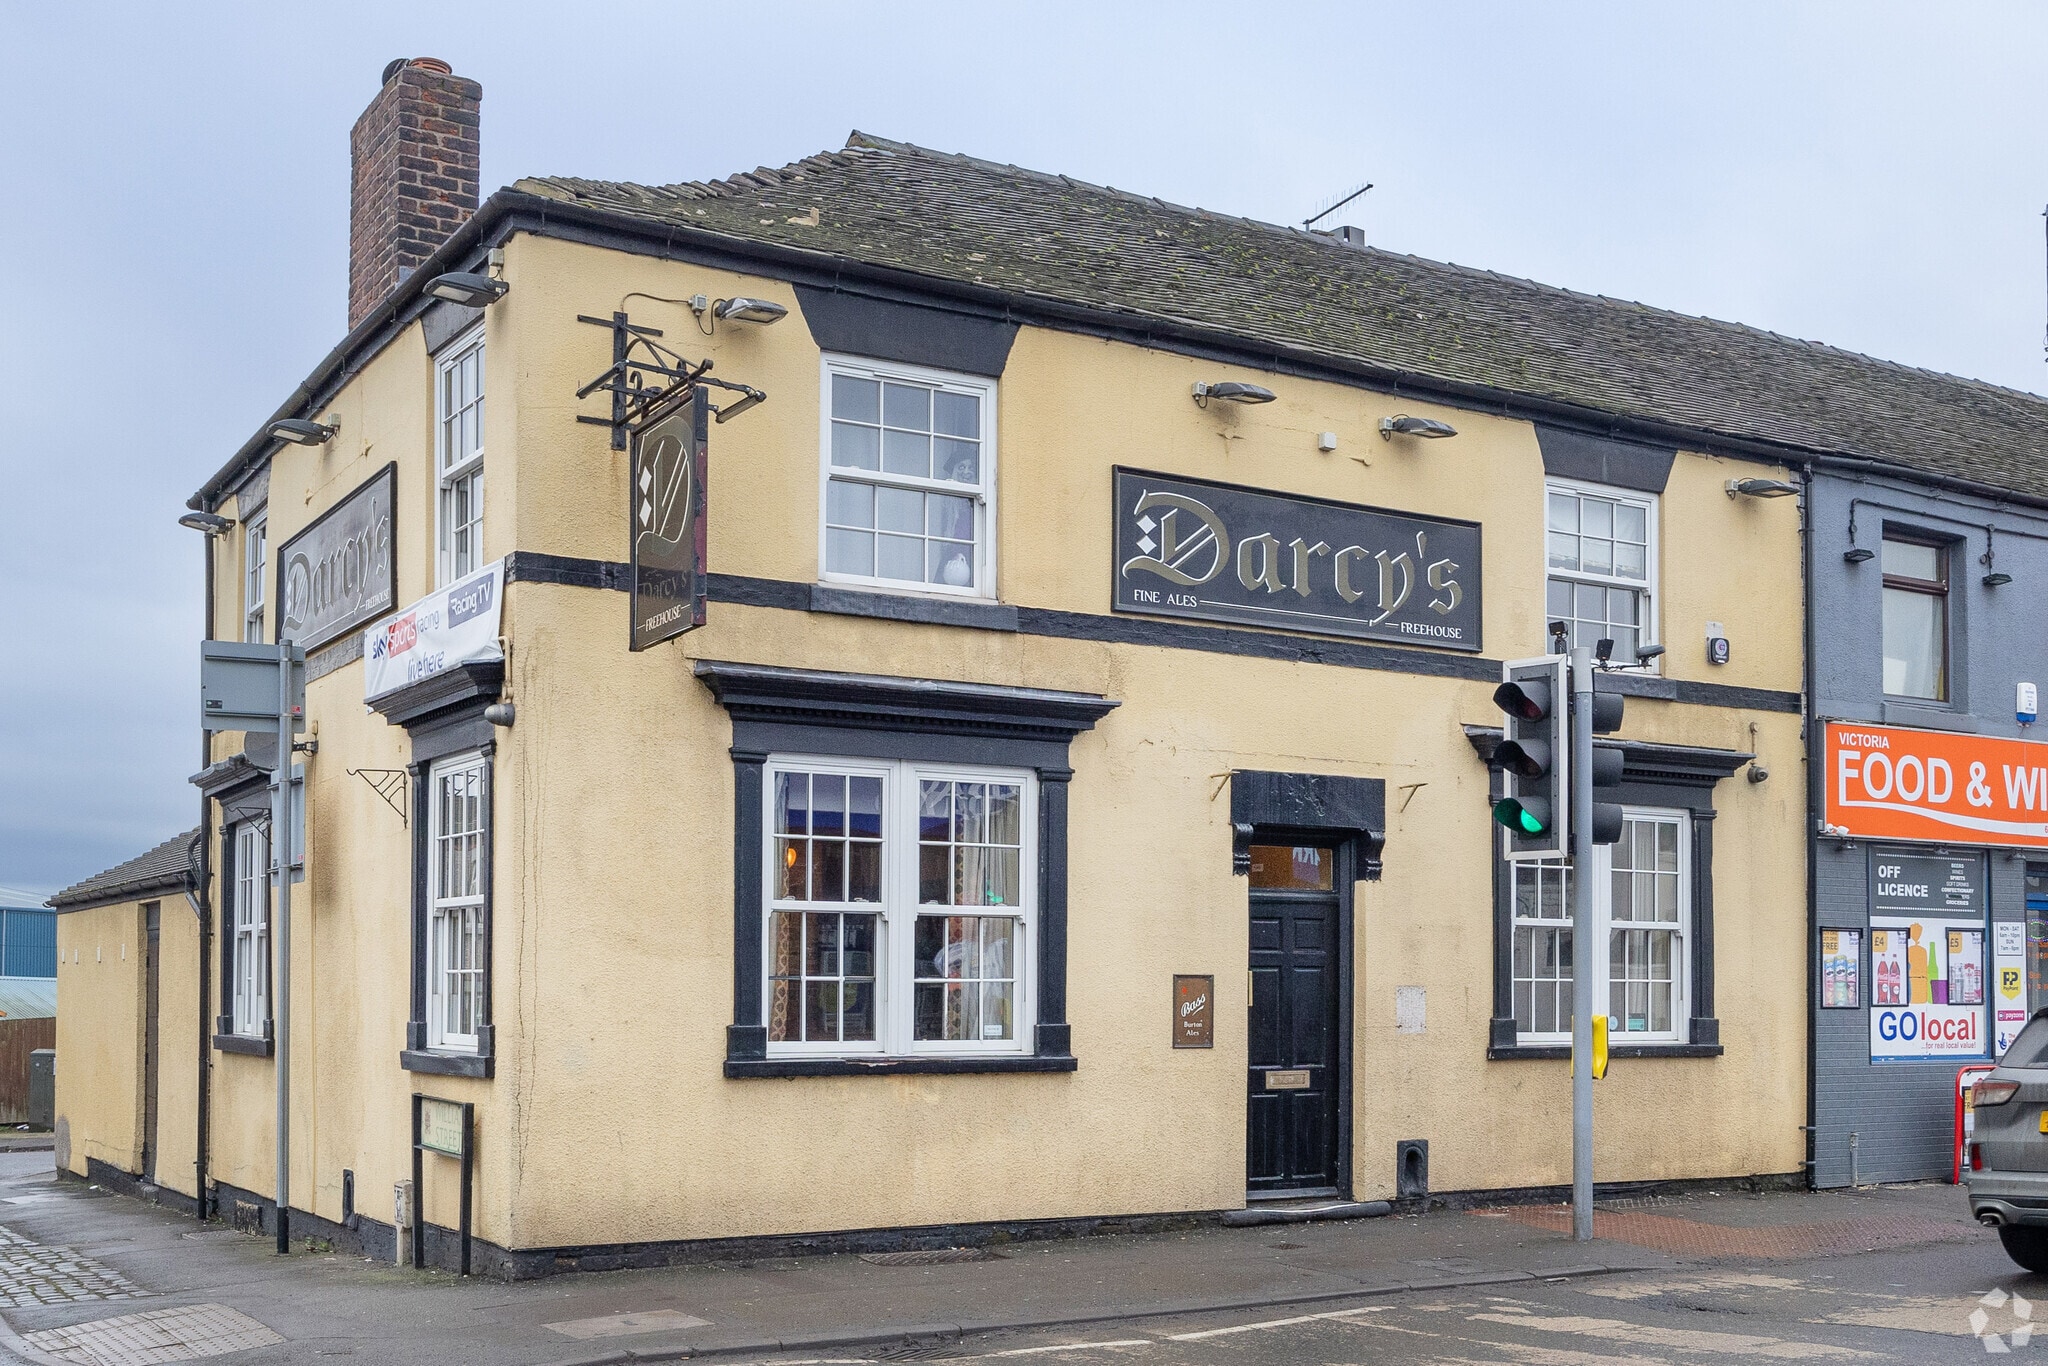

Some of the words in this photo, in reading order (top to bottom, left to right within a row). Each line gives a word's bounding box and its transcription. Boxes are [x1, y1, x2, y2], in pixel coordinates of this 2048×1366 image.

[1122, 489, 1463, 626] Darcy's
[281, 497, 390, 638] Darcy's
[365, 588, 390, 611] FREEHOUSE
[451, 592, 478, 616] Racing
[477, 582, 491, 604] TV
[1133, 589, 1160, 604] FINE
[1166, 592, 1198, 608] ALES
[645, 604, 682, 632] FREEHOUSE
[372, 633, 389, 660] sky
[389, 621, 417, 653] sports
[417, 610, 440, 634] racing
[1400, 621, 1463, 639] FREEHOUSE
[422, 650, 445, 676] here
[1838, 732, 1890, 749] VICTORIA
[1838, 749, 1954, 807] FOOD
[1966, 761, 1994, 808] &
[1877, 864, 1901, 879] OFF
[1877, 883, 1929, 898] LICENCE
[1874, 936, 1884, 946] £4
[1950, 938, 1959, 948] £5
[1180, 993, 1206, 1018] Bass
[1183, 1020, 1203, 1029] Burton
[1185, 1029, 1200, 1037] Ales
[1934, 1041, 1946, 1049] real
[1946, 1041, 1959, 1049] local
